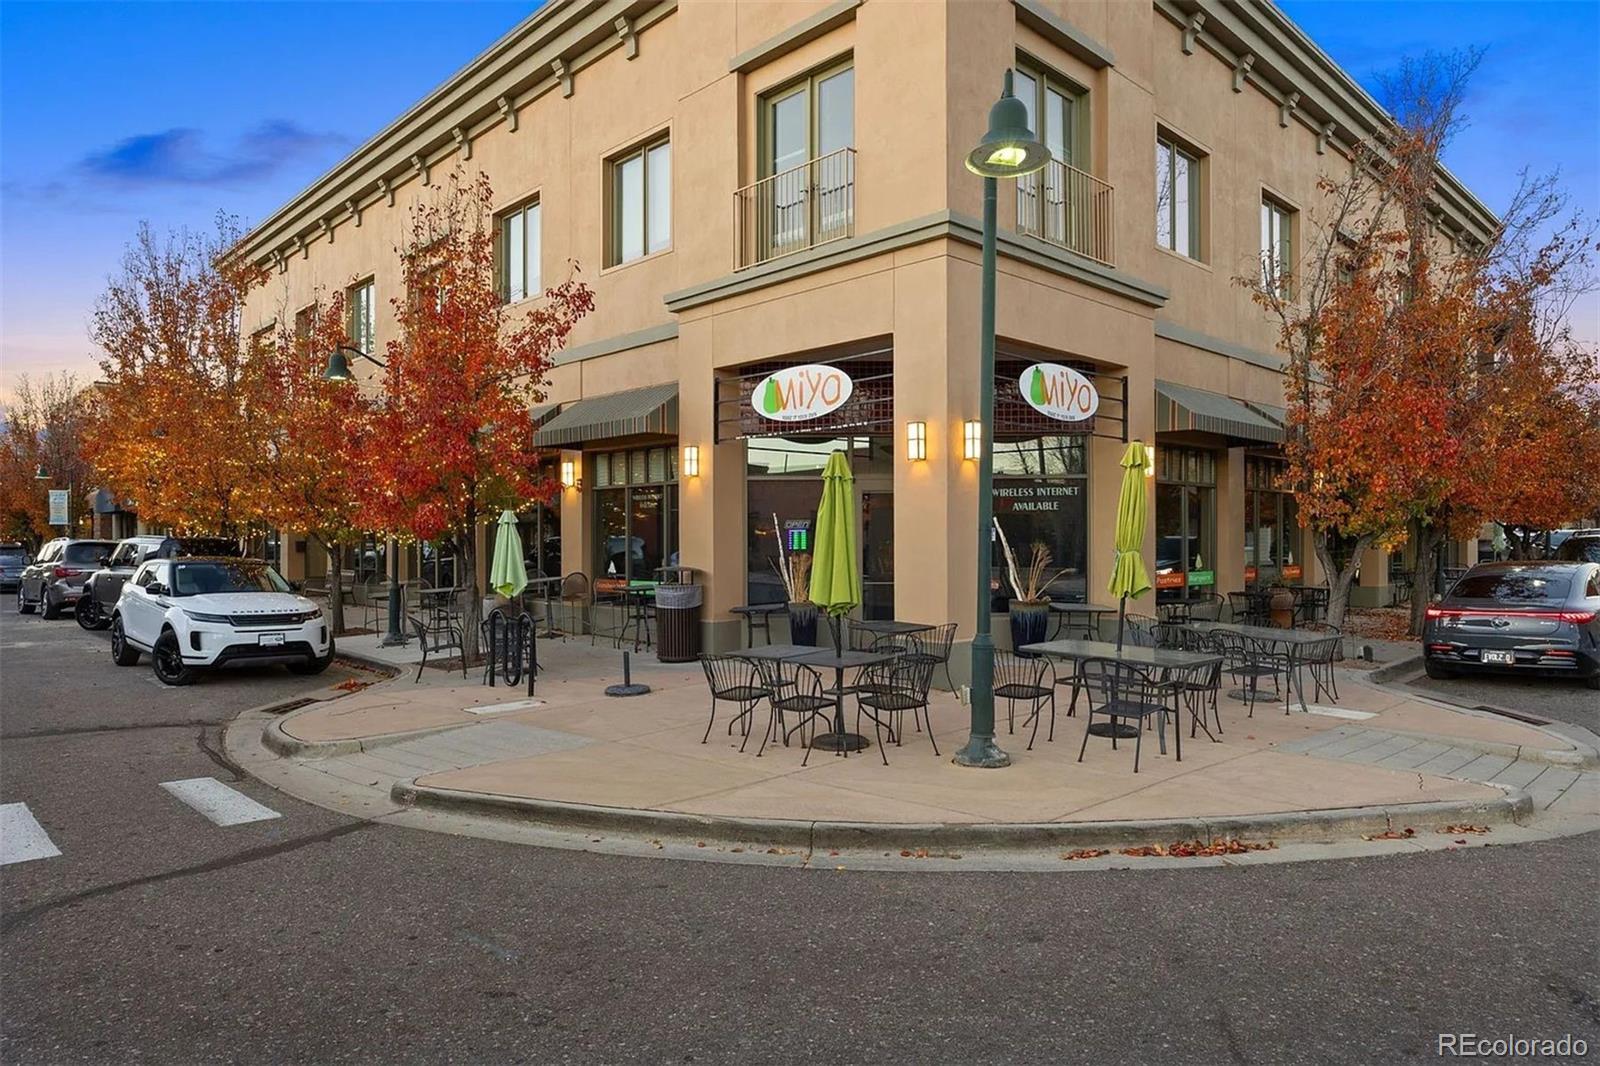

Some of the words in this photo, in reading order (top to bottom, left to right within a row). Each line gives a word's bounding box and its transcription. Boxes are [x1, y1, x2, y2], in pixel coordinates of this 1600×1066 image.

[992, 487, 1034, 497] WIRELESS
[1036, 486, 1079, 496] INTERNET
[1012, 501, 1060, 511] AVAILABLE
